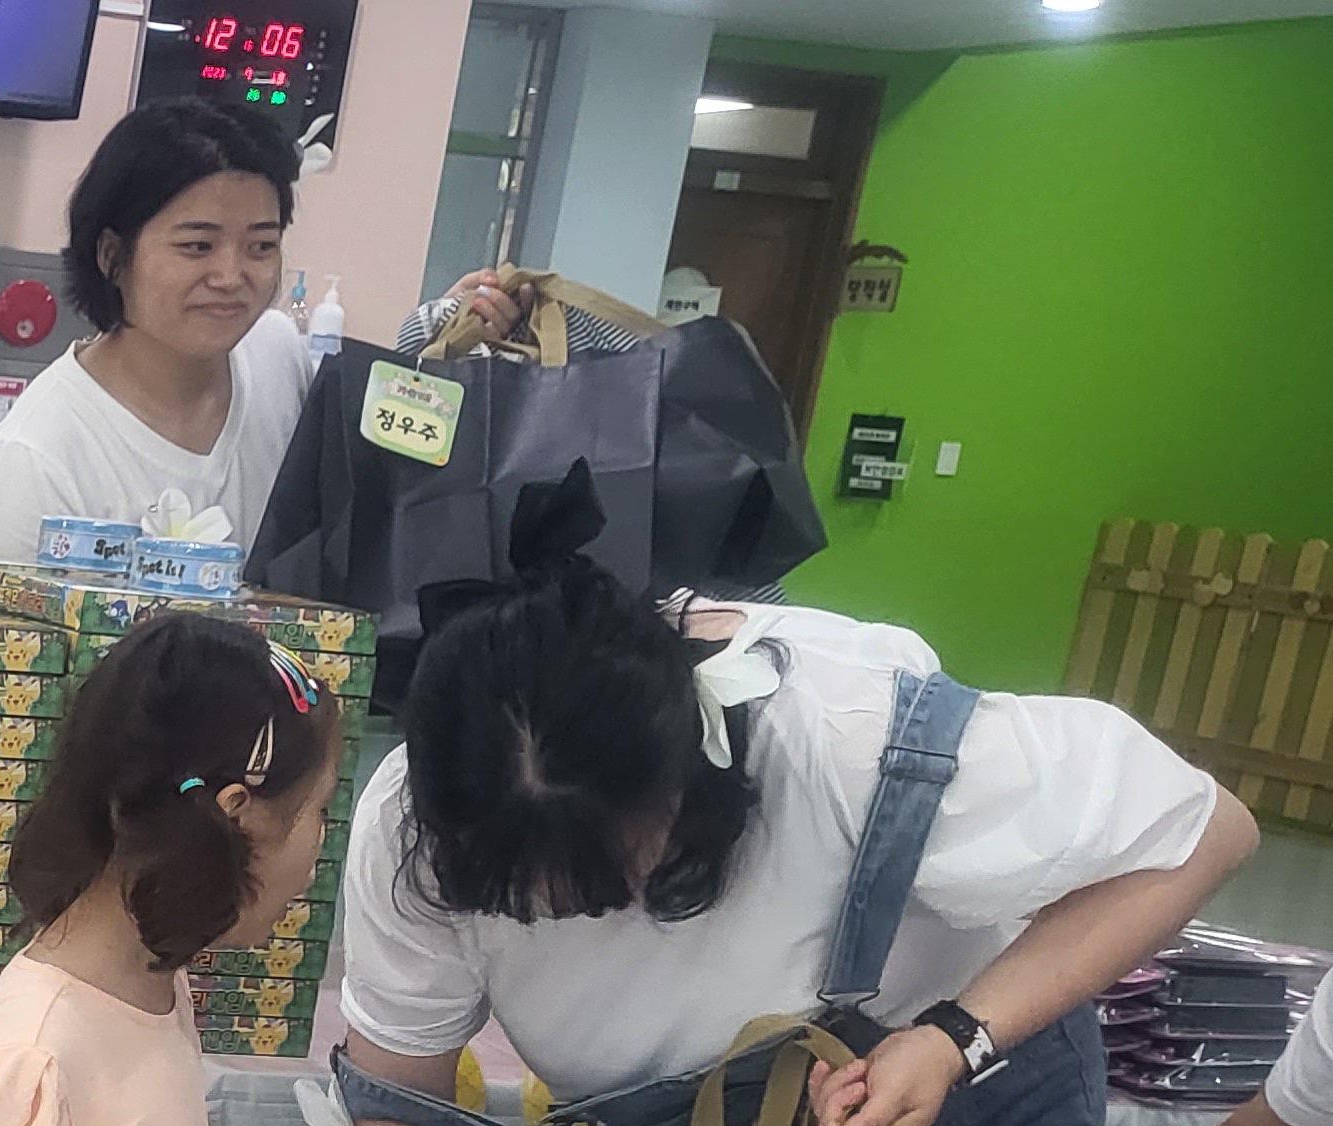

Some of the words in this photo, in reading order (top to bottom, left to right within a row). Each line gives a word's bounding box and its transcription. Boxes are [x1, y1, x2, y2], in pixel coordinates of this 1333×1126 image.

[205, 18, 238, 51] 12
[261, 23, 305, 58] 06
[375, 406, 439, 442] 정우주
